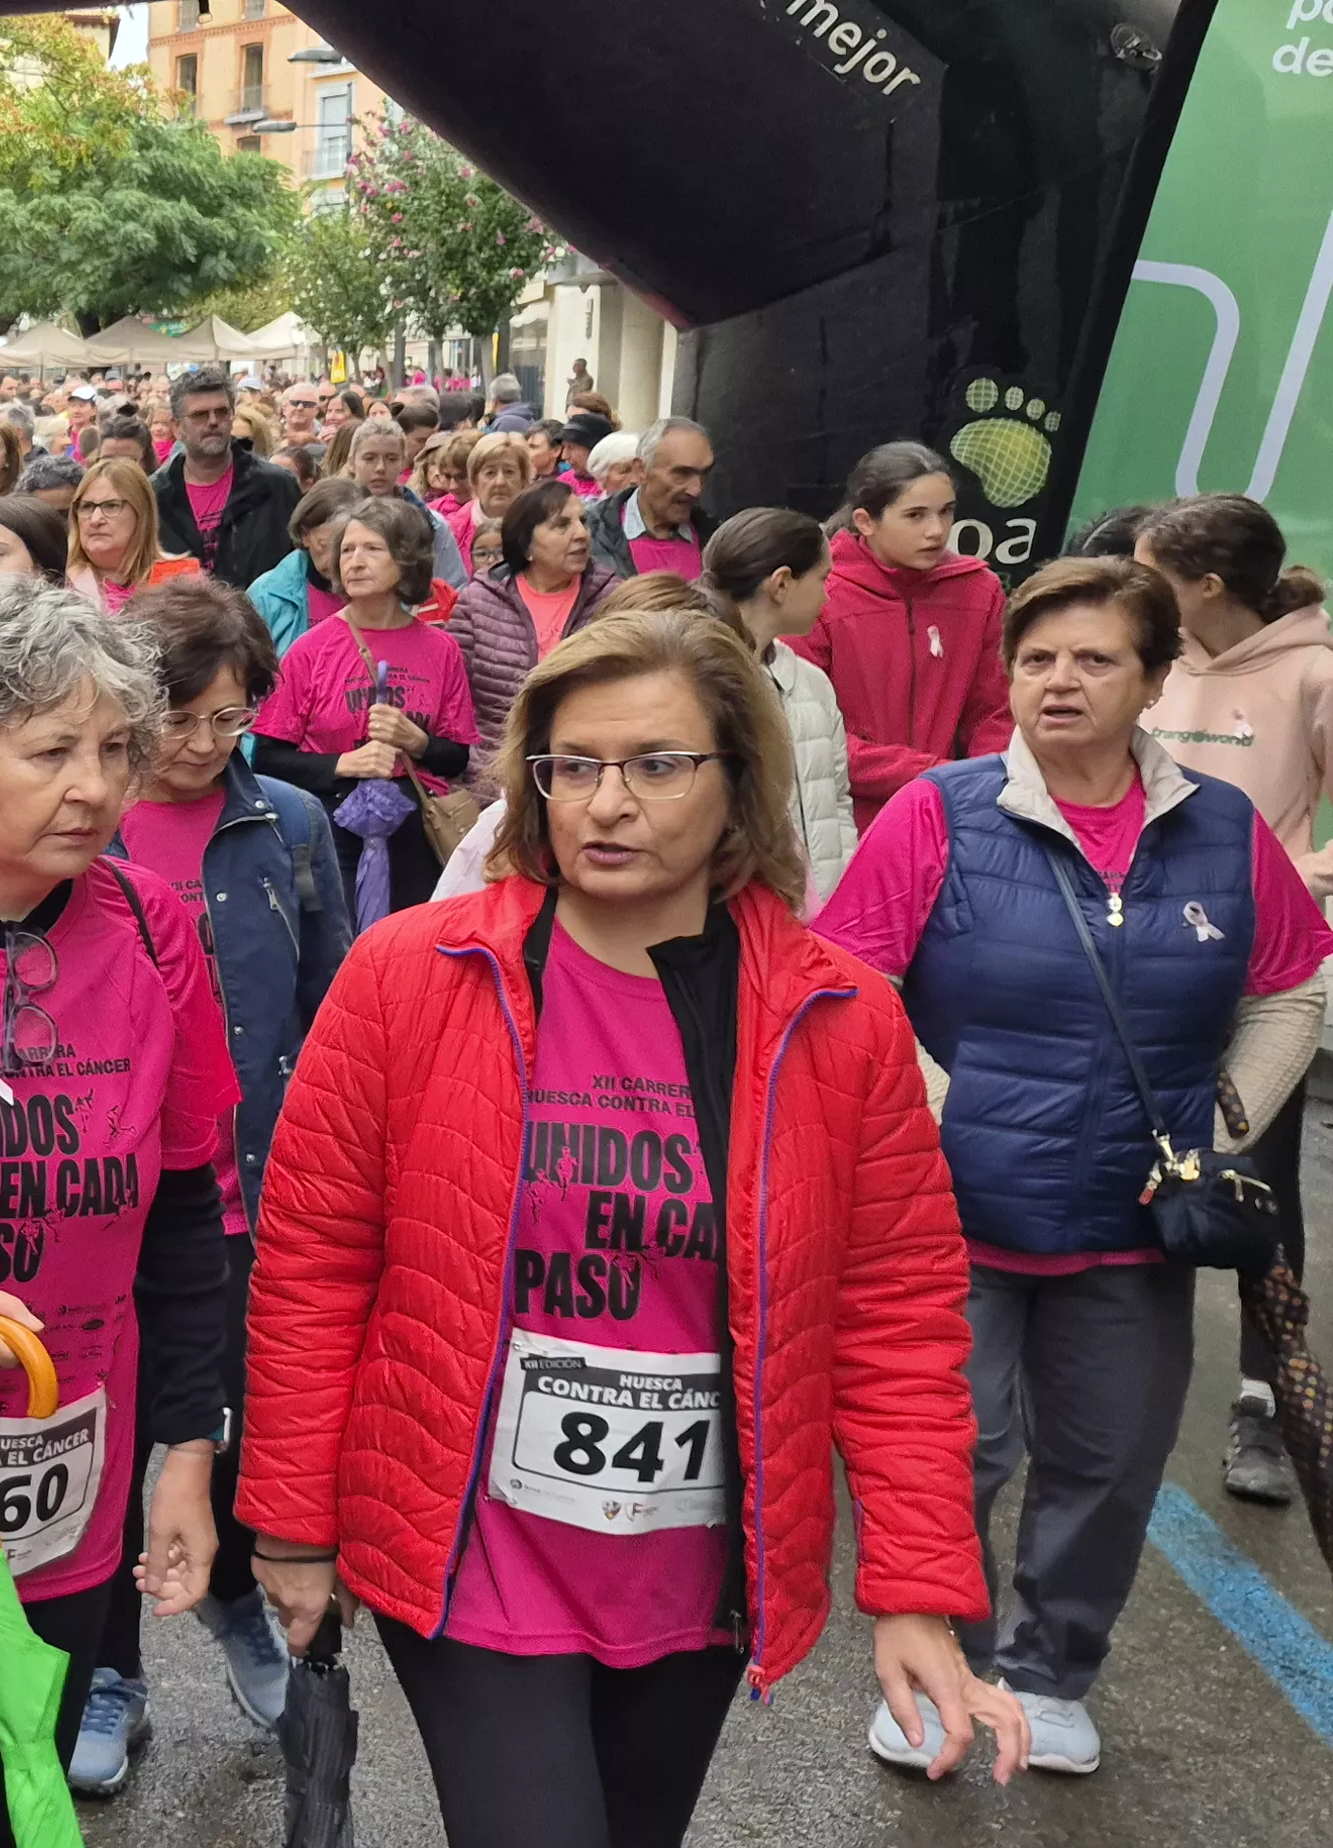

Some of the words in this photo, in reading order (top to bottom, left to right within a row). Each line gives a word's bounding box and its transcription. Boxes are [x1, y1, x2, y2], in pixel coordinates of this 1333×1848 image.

[785, 0, 921, 95] mejor
[57, 1063, 74, 1077] EL
[77, 1058, 131, 1076] CÁNCER
[592, 1076, 615, 1090] XII
[621, 1077, 692, 1097] CARRER
[597, 1095, 671, 1114] CONTRA
[525, 1121, 694, 1195] UNIDOS
[56, 1152, 139, 1218] CADA
[586, 1191, 648, 1251] EN
[656, 1198, 717, 1262] CA
[515, 1249, 643, 1321] PASO
[537, 1375, 634, 1407] CONTRA
[639, 1392, 664, 1410] EL
[668, 1388, 721, 1409] CÁNC
[619, 1374, 683, 1392] HUESCA
[7, 1451, 28, 1465] EL
[33, 1428, 91, 1462] CÁNCER
[554, 1411, 711, 1483] 841
